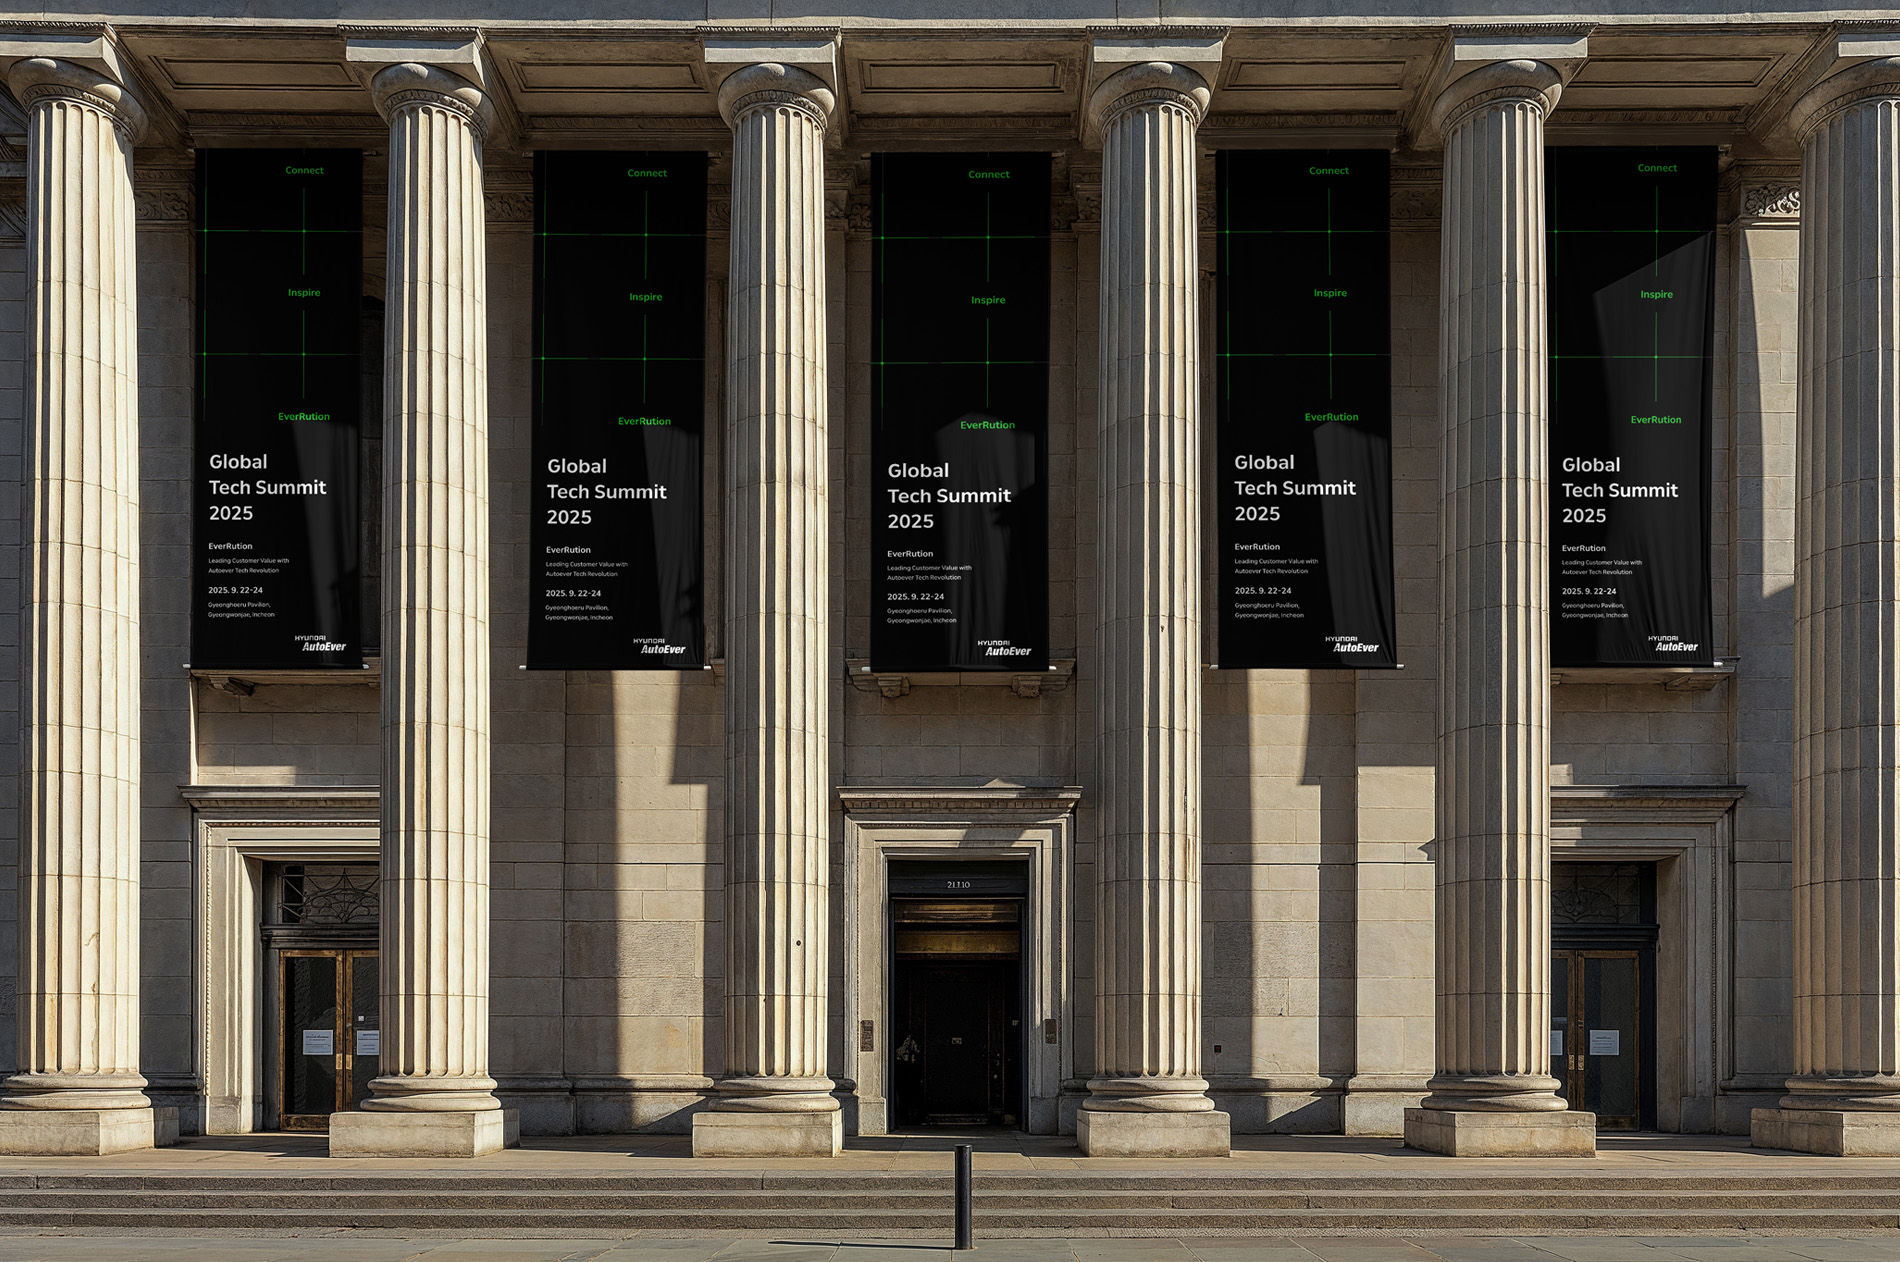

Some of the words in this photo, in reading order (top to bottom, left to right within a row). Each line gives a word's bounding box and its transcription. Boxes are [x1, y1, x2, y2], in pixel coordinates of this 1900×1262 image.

[286, 165, 324, 175] Connect
[628, 168, 667, 178] Connect
[1310, 166, 1349, 175] Connect
[1638, 163, 1677, 173] Connect
[969, 170, 1010, 179] Connect
[289, 287, 320, 299] Inspire
[630, 292, 663, 303] Inspire
[1314, 288, 1347, 299] Inspire
[1641, 289, 1673, 301] Inspire
[972, 295, 1005, 306] Inspire
[279, 411, 330, 421] EverRution
[619, 416, 671, 426] EverRution
[1305, 412, 1358, 422] EverRution
[1631, 415, 1681, 425] EverRution
[961, 419, 1015, 430] EverRution
[210, 454, 267, 469] Global
[548, 458, 606, 473] Global
[1235, 455, 1294, 469] Global
[1563, 457, 1620, 472] Global
[888, 463, 948, 478] Global
[209, 480, 250, 494] Tech
[256, 479, 327, 494] Summit
[547, 484, 589, 498] Tech
[595, 484, 667, 499] Summit
[1234, 481, 1277, 495] Tech
[1283, 480, 1356, 495] Summit
[1562, 483, 1603, 497] Tech
[1609, 482, 1678, 497] Summit
[888, 489, 931, 503] Tech
[937, 488, 1011, 503] Summit
[210, 506, 253, 520] 2025
[547, 510, 591, 524] 2025
[1235, 506, 1280, 521] 2025
[1563, 508, 1606, 523] 2025
[888, 514, 933, 528] 2025
[209, 542, 252, 550] EverRution
[546, 545, 591, 554] EverRution
[1235, 542, 1280, 551] EverRution
[1562, 544, 1606, 552] EverRution
[888, 549, 933, 558] EverRution
[209, 557, 231, 565] Leading
[546, 560, 569, 569] Leading
[570, 560, 597, 568] Customer
[598, 560, 615, 568] Value
[1235, 558, 1258, 566] Leading
[1259, 557, 1287, 565] Customer
[1562, 559, 1585, 567] Leading
[887, 565, 911, 573] Leading
[912, 564, 940, 572] Customer
[942, 564, 958, 572] Value
[1262, 567, 1276, 575] Tech
[1277, 567, 1308, 575] Revolution
[1603, 568, 1632, 576] Revolution
[587, 570, 618, 578] Revolution
[930, 573, 961, 581] Revolution
[209, 586, 229, 595] 2025.
[231, 586, 238, 595] 9.
[240, 586, 263, 595] 22-24
[546, 589, 567, 598] 2025.
[569, 589, 576, 598] 9.
[578, 589, 601, 598] 22-24
[1235, 586, 1257, 595] 2025.
[1259, 586, 1266, 595] 9.
[1268, 586, 1291, 595] 22-24
[1562, 587, 1583, 596] 2025.
[1585, 587, 1592, 596] 9.
[1594, 587, 1616, 596] 22-24
[888, 592, 909, 601] 2025.
[911, 592, 918, 601] 9.
[921, 592, 944, 601] 22-24
[248, 601, 271, 609] Pavilion,
[585, 604, 609, 612] Pavilion,
[1276, 602, 1300, 610] Pavilion,
[1601, 602, 1624, 610] Pavilion,
[928, 607, 952, 615] Pavilion,
[302, 641, 346, 652] AutoEver
[641, 644, 686, 655] AutoEver
[985, 646, 1031, 657] AutoEver
[1333, 642, 1379, 653] AutoEver
[1656, 641, 1698, 652] AutoEver
